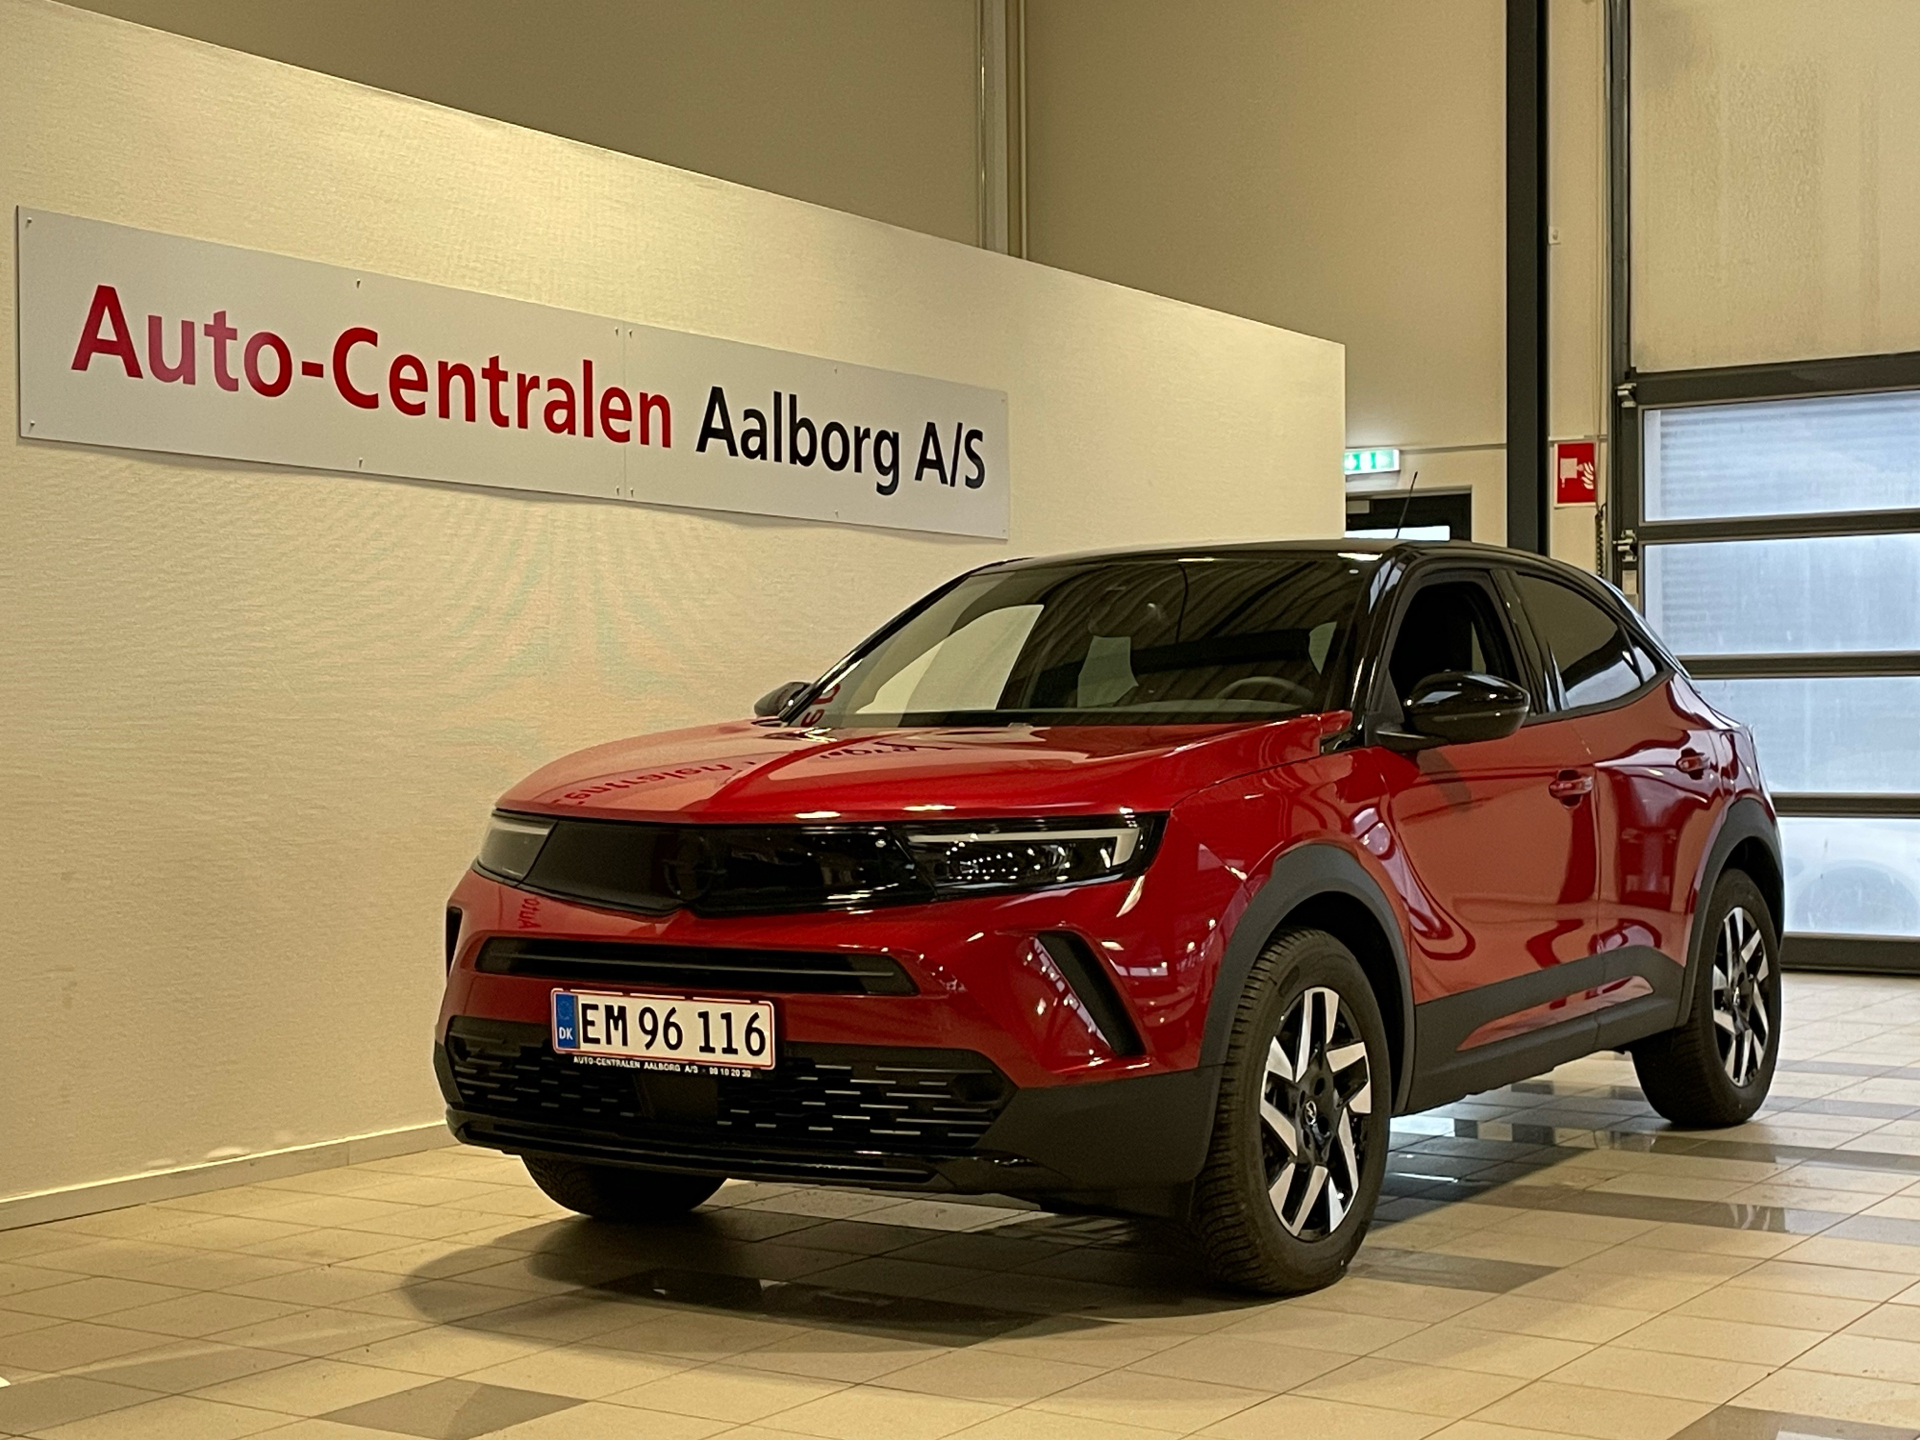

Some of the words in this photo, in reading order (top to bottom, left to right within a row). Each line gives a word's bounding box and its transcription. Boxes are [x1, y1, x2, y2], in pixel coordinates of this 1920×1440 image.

[71, 284, 672, 448] Auto-Centralen
[695, 385, 899, 496] Aalborg
[914, 421, 986, 489] A/S
[559, 1027, 574, 1041] DK
[581, 1003, 628, 1047] EM
[638, 1006, 683, 1051] 96
[697, 1010, 766, 1057] 116
[573, 1056, 641, 1069] AUTO-CENTRALEN
[644, 1061, 681, 1072] AALBORG
[684, 1064, 699, 1074] A/S
